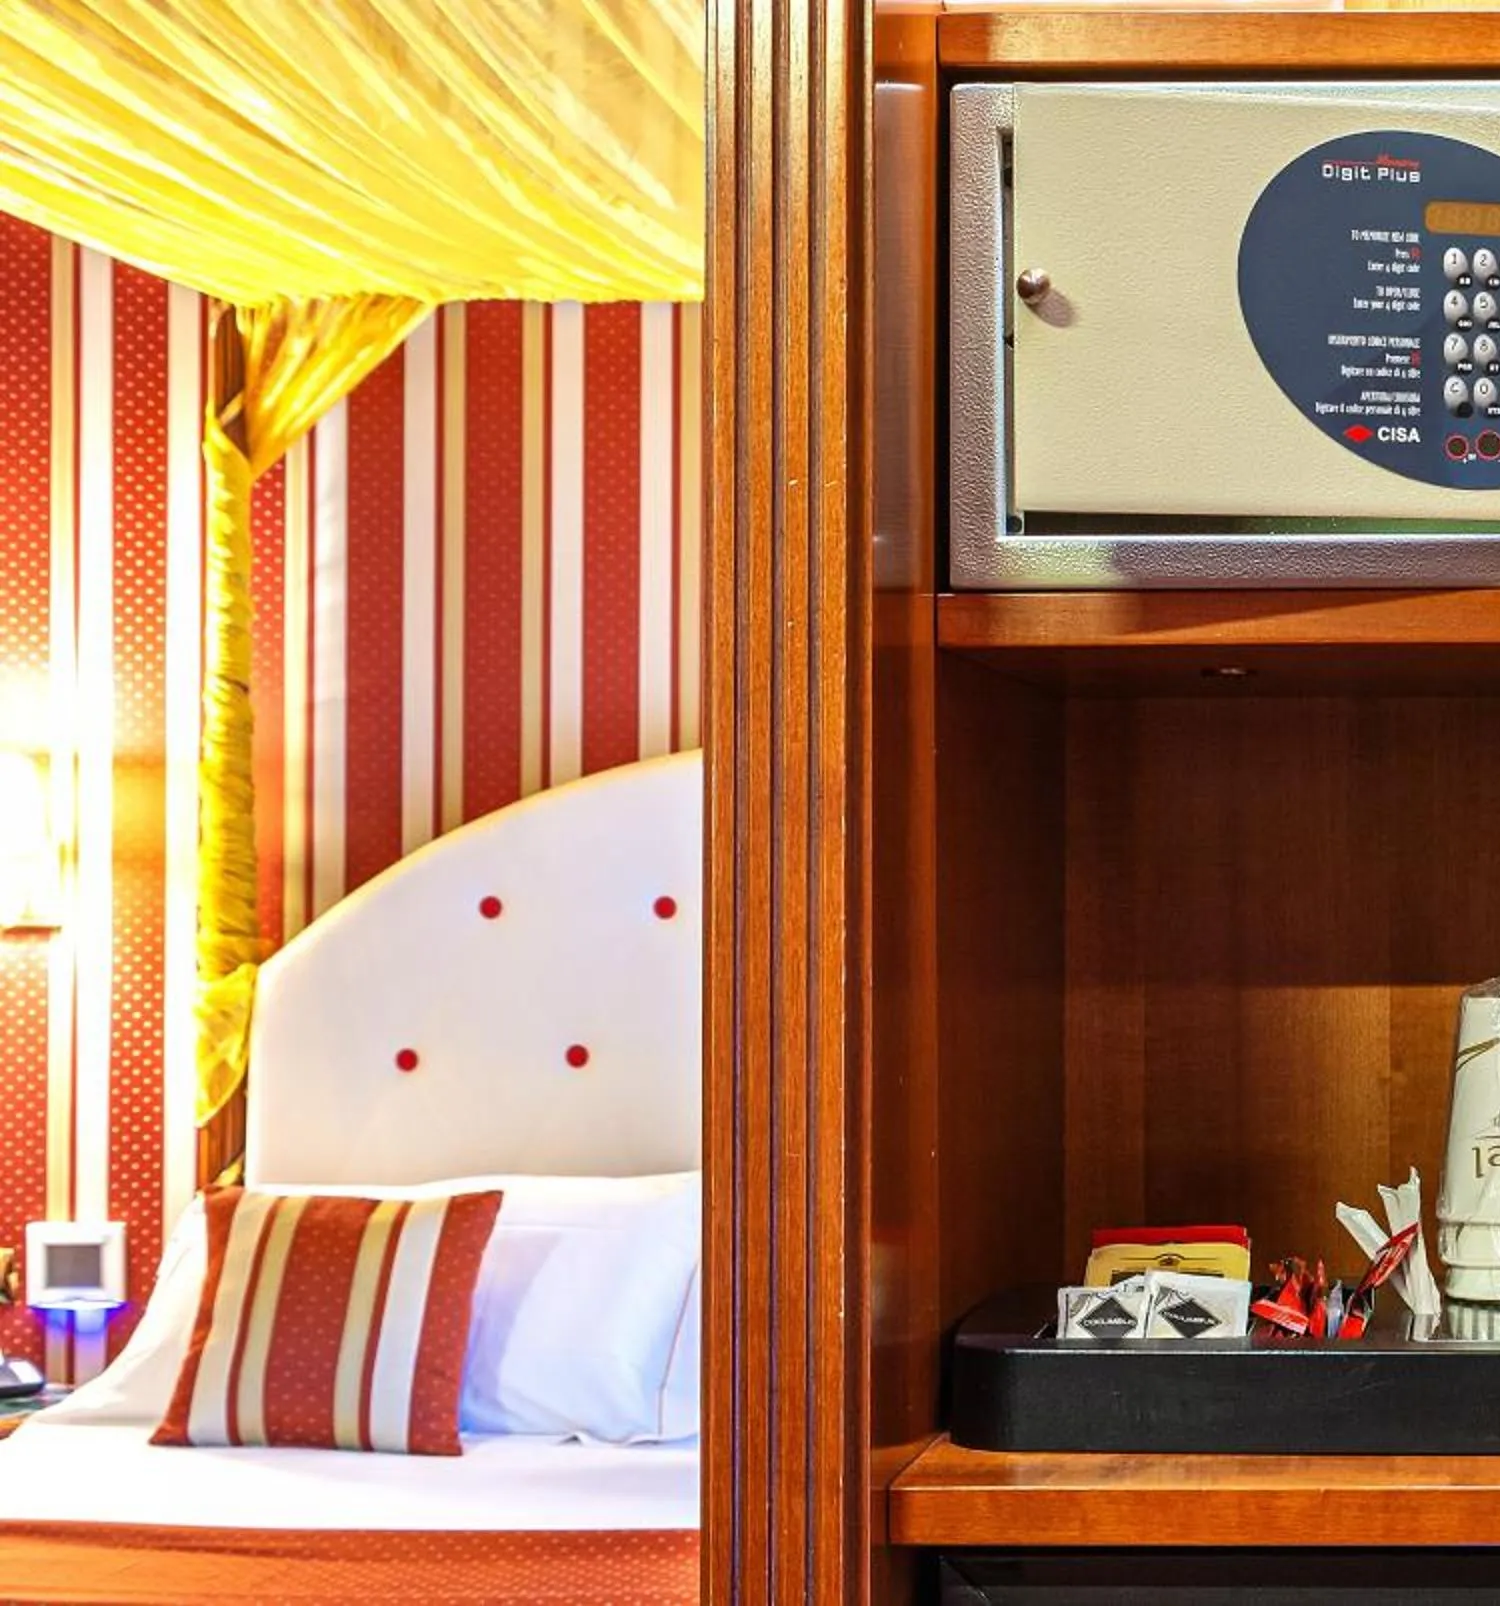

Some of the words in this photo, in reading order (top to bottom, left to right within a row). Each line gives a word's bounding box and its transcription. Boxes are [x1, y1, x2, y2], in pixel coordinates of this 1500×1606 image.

[1322, 163, 1371, 181] Digit
[1377, 167, 1420, 183] Plus
[1451, 253, 1457, 265] 1
[1479, 254, 1487, 266] 2
[1450, 296, 1458, 306] 4
[1479, 297, 1488, 309] 5
[1450, 338, 1457, 351] 7
[1479, 340, 1488, 352] 8
[1450, 382, 1459, 393] C
[1377, 426, 1421, 443] CISA
